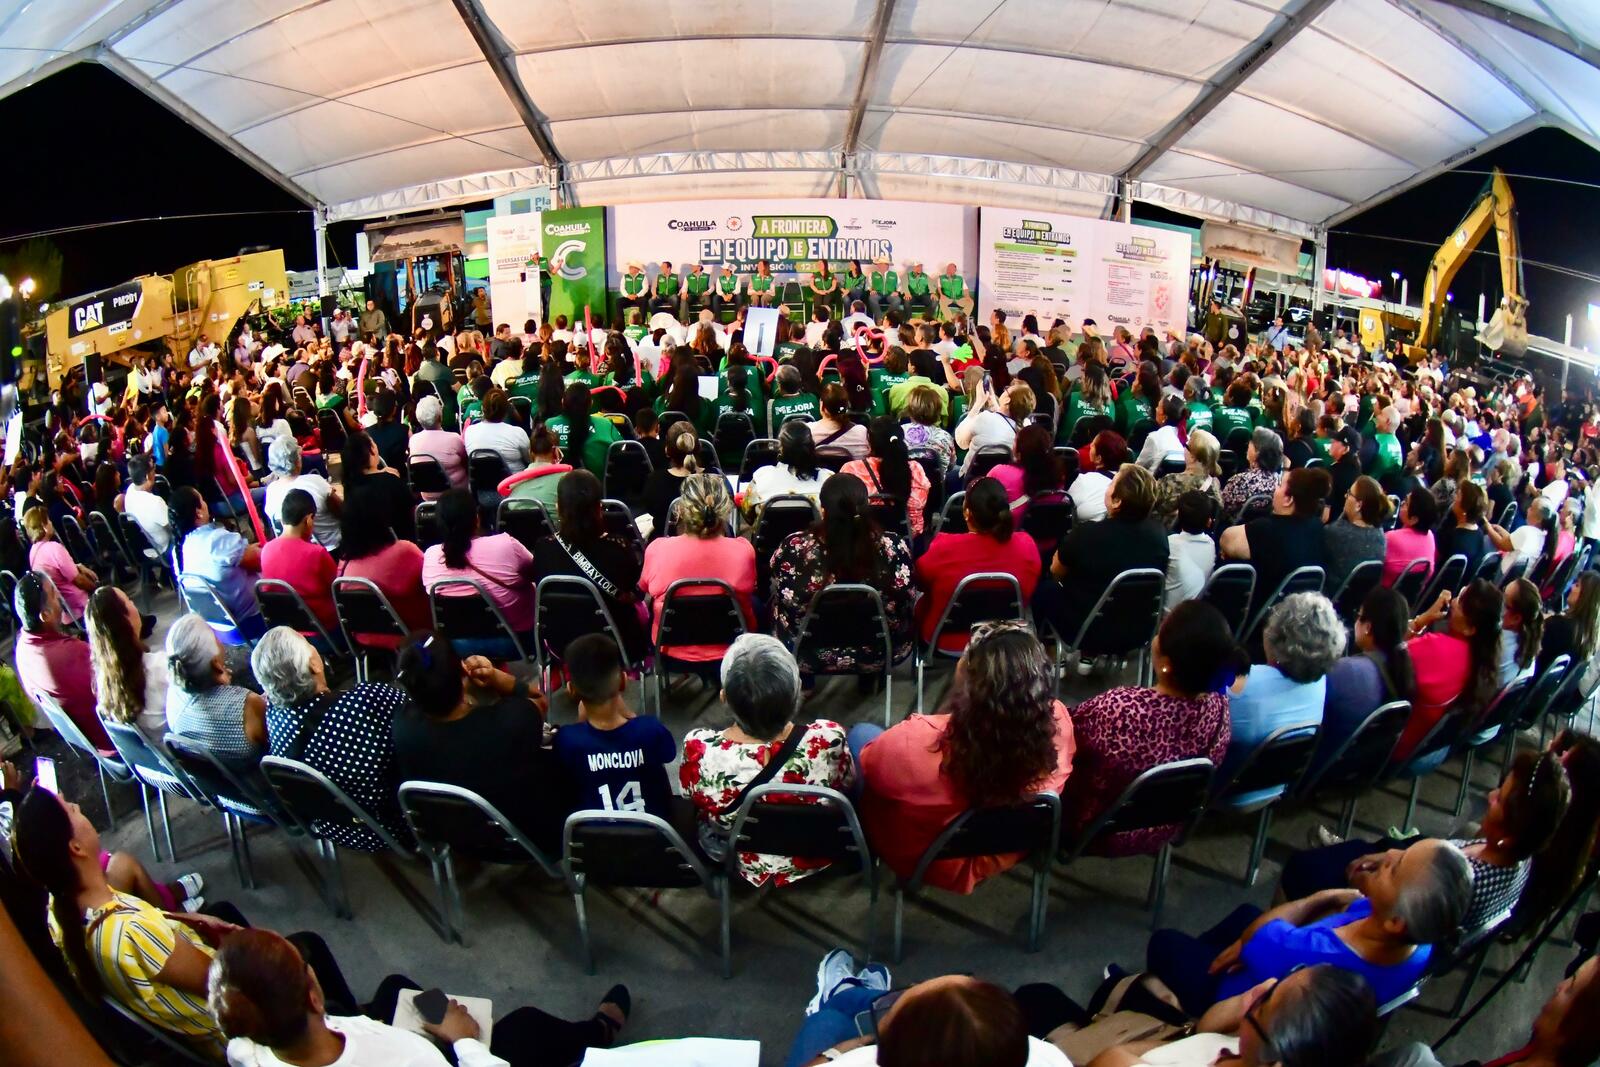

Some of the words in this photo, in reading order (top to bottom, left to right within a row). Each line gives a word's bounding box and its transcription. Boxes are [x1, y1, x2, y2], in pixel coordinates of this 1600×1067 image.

[545, 222, 591, 236] COAHUILA
[667, 219, 717, 230] COAHUILA
[761, 219, 769, 234] A
[771, 219, 828, 234] FRONTERA
[700, 239, 721, 261] EN
[725, 238, 788, 262] EQUIPO
[793, 240, 804, 257] LE
[808, 238, 891, 261] ENTRAMOS
[740, 260, 794, 272] INVSIÓN
[112, 292, 138, 308] PM201
[74, 301, 104, 332] CAT
[775, 402, 815, 416] MEJORA
[587, 748, 644, 772] MONCLOVA
[598, 781, 646, 812] 14
